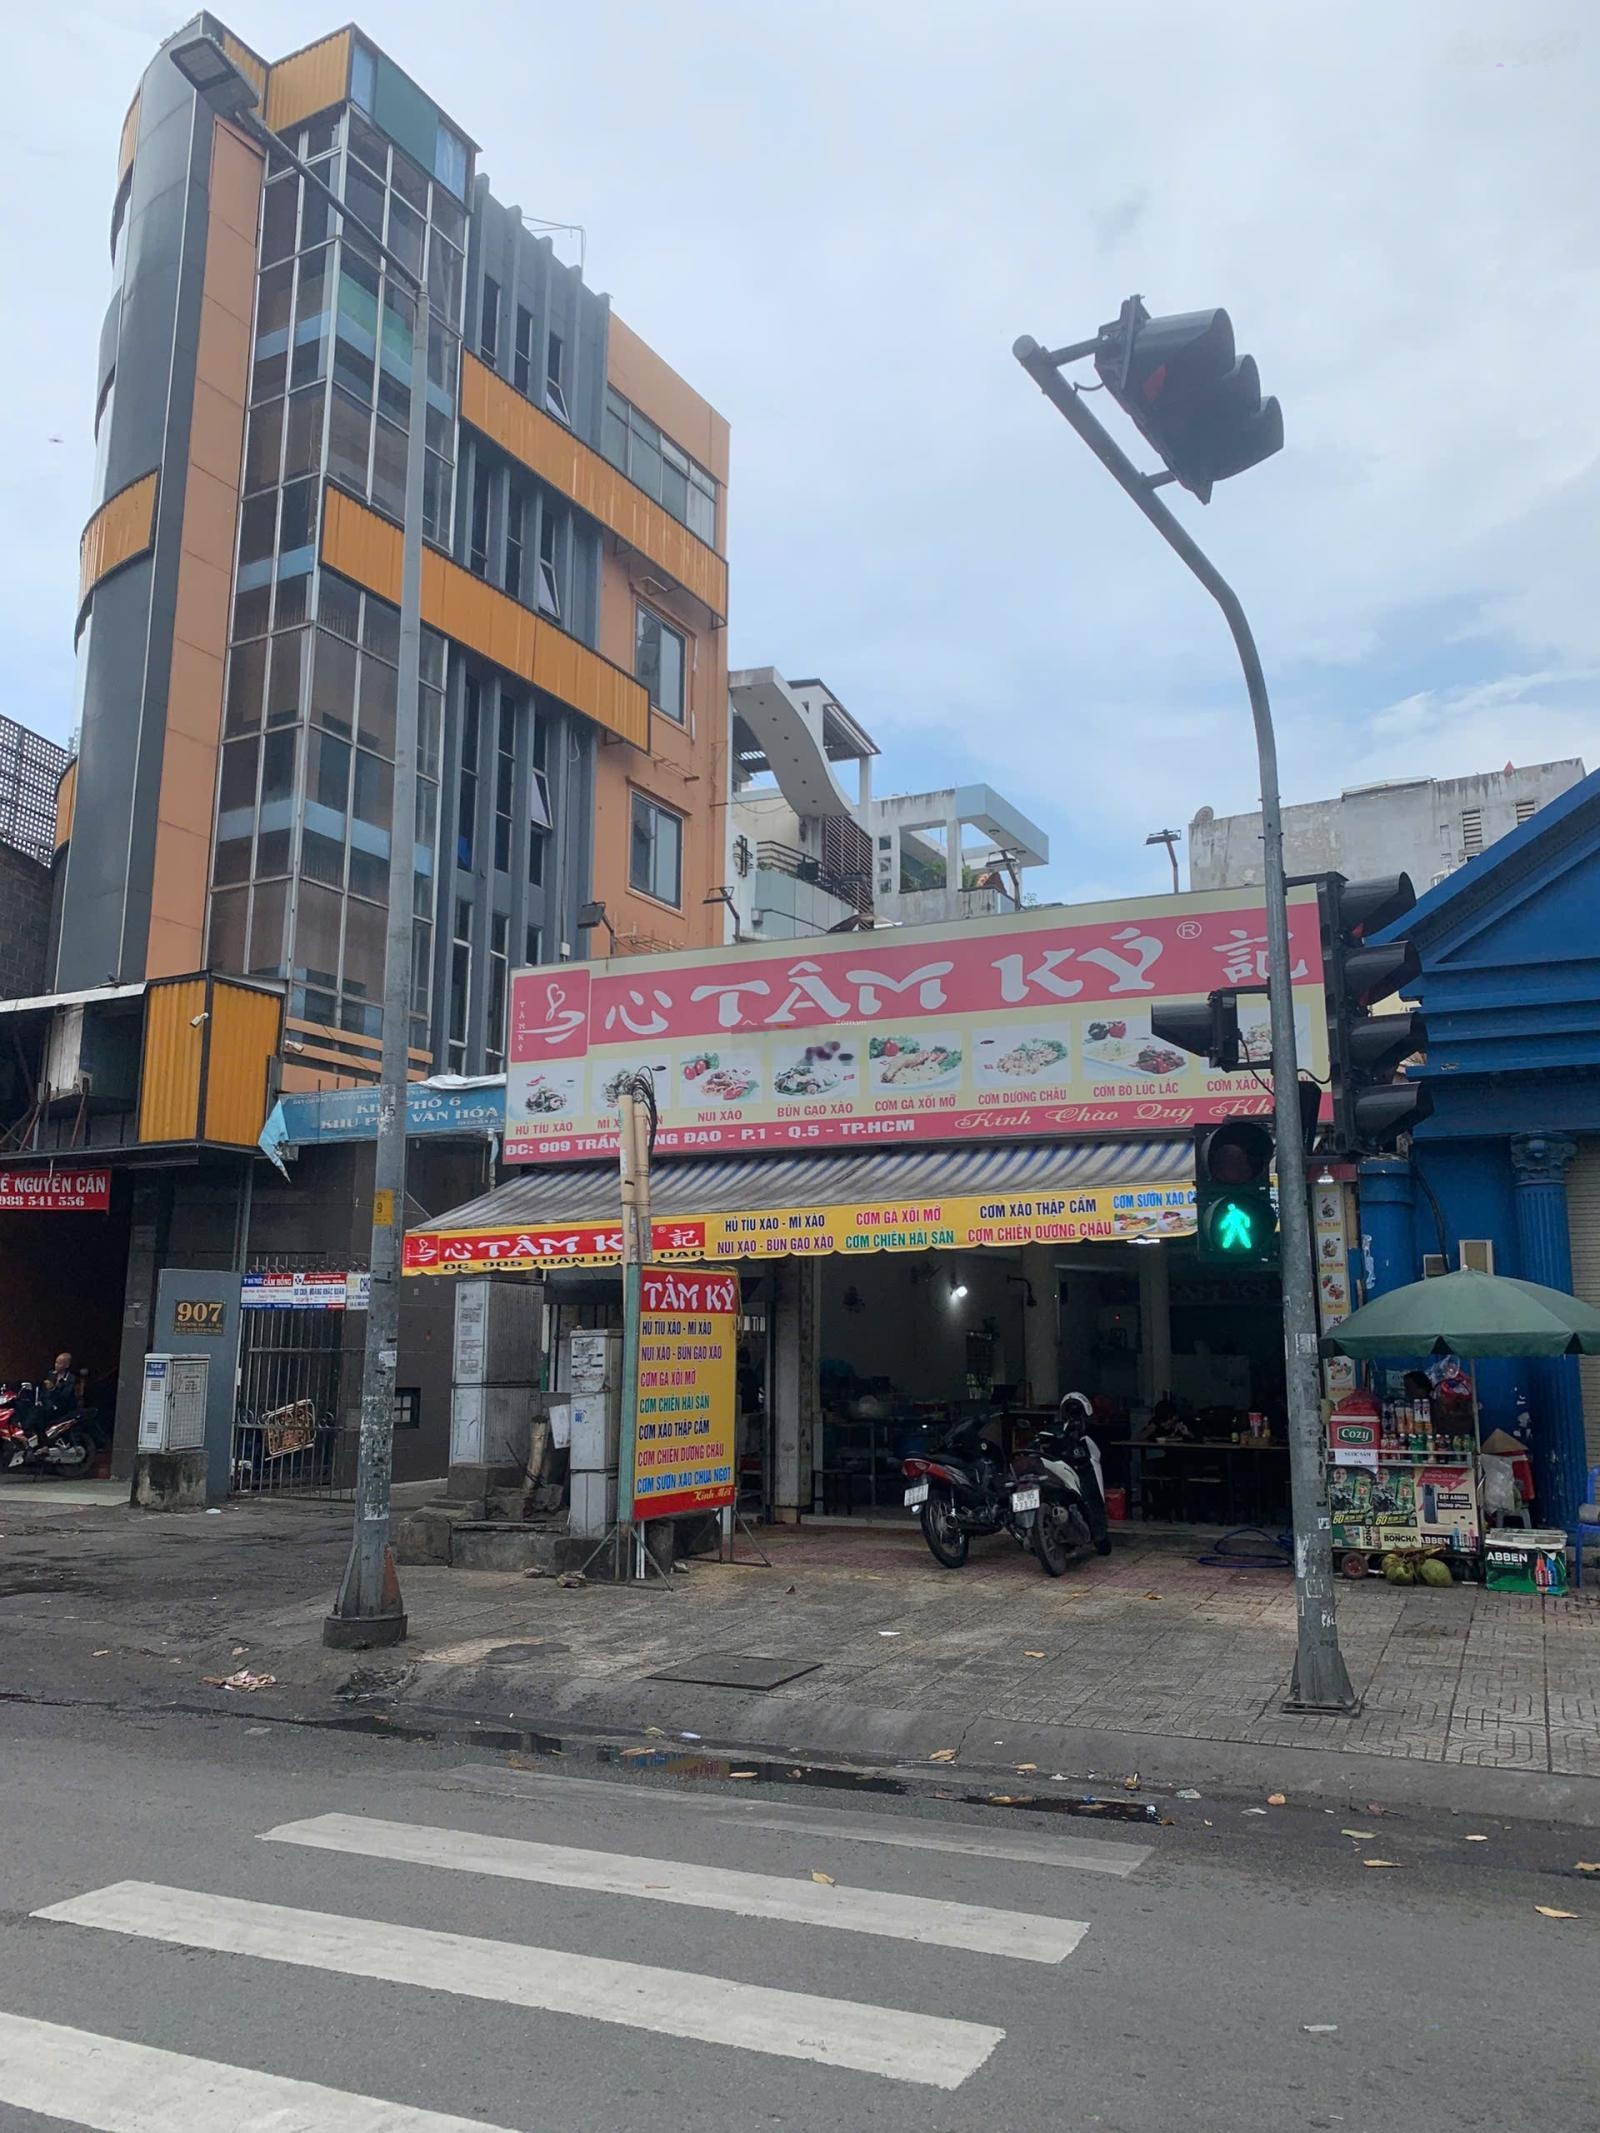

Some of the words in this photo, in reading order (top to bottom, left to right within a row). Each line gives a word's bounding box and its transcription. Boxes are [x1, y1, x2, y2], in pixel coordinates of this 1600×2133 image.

[690, 960, 955, 1027] TÂM
[605, 989, 673, 1035] 心
[1093, 1085, 1115, 1097] CƠM
[1207, 1078, 1231, 1091] CƠM
[1235, 1075, 1259, 1090] XÀO
[449, 1096, 461, 1107] 6
[874, 1098, 897, 1112] CƠM
[901, 1096, 915, 1109] GÀ
[978, 1092, 1000, 1105] CƠM
[1040, 1087, 1067, 1102] CHÂU
[698, 1111, 717, 1122] NUI
[720, 1107, 742, 1120] XÀO
[777, 1103, 801, 1117] BÚN
[804, 1103, 826, 1117] GẠO
[831, 1100, 853, 1114] XÀO
[1045, 1105, 1119, 1123] Chào
[1133, 1102, 1194, 1124] Quý
[553, 1119, 573, 1132] XÀO
[539, 1140, 570, 1153] 909
[684, 1130, 721, 1144] ĐẠO
[741, 1128, 766, 1140] P.1
[788, 1125, 819, 1138] Q.5
[840, 1119, 915, 1134] TP.HCM
[15, 1173, 71, 1193] NGUYÊN
[76, 1173, 106, 1193] CĂN
[28, 1196, 53, 1206] 541
[58, 1196, 85, 1206] 556
[980, 1203, 1005, 1218] CƠM
[1009, 1200, 1032, 1217] XÀO
[1035, 1199, 1066, 1218] THẬP
[1070, 1193, 1096, 1214] CẨM
[1113, 1192, 1134, 1208] CƠM
[1137, 1189, 1162, 1206] SƯỜN
[1165, 1187, 1184, 1205] XÀO
[725, 1215, 738, 1232] HỦ
[759, 1213, 779, 1230] XÀO
[805, 1211, 825, 1228] XÀO
[856, 1211, 880, 1225] CƠM
[884, 1208, 898, 1224] GÀ
[669, 1228, 699, 1247] 記
[845, 1233, 869, 1248] CƠM
[873, 1230, 906, 1247] CHIÊN
[909, 1227, 927, 1245] HẢI
[931, 1226, 954, 1244] SẢN
[968, 1227, 993, 1242] CƠM
[997, 1223, 1031, 1240] CHIÊN
[1035, 1221, 1076, 1239] DƯƠNG
[1079, 1218, 1112, 1236] CHÂU
[445, 1242, 473, 1259] 心
[478, 1235, 580, 1257] TÂM
[593, 1233, 623, 1252] K
[717, 1240, 735, 1254] NUI
[737, 1237, 757, 1253] XÀO
[766, 1235, 787, 1251] BÚN
[790, 1236, 810, 1252] GẠO
[813, 1233, 834, 1249] XÀO
[644, 1274, 700, 1309] TÂM
[177, 1302, 222, 1322] 907
[667, 1318, 681, 1335] XÀO
[699, 1318, 712, 1335] XÀO
[641, 1346, 654, 1360] NUI
[640, 1370, 657, 1387] CƠM
[640, 1397, 656, 1413] CƠM
[658, 1394, 680, 1412] CHIÊN
[639, 1423, 656, 1440] CƠM
[657, 1420, 672, 1438] XÀO
[674, 1418, 692, 1439] THẬP
[1341, 1428, 1369, 1442] Cozy
[638, 1449, 655, 1466] CƠM
[657, 1445, 678, 1464] CHIÊN
[637, 1476, 654, 1493] CƠM
[1384, 1535, 1419, 1543] BONCHA
[1487, 1551, 1528, 1563] ABBEN
